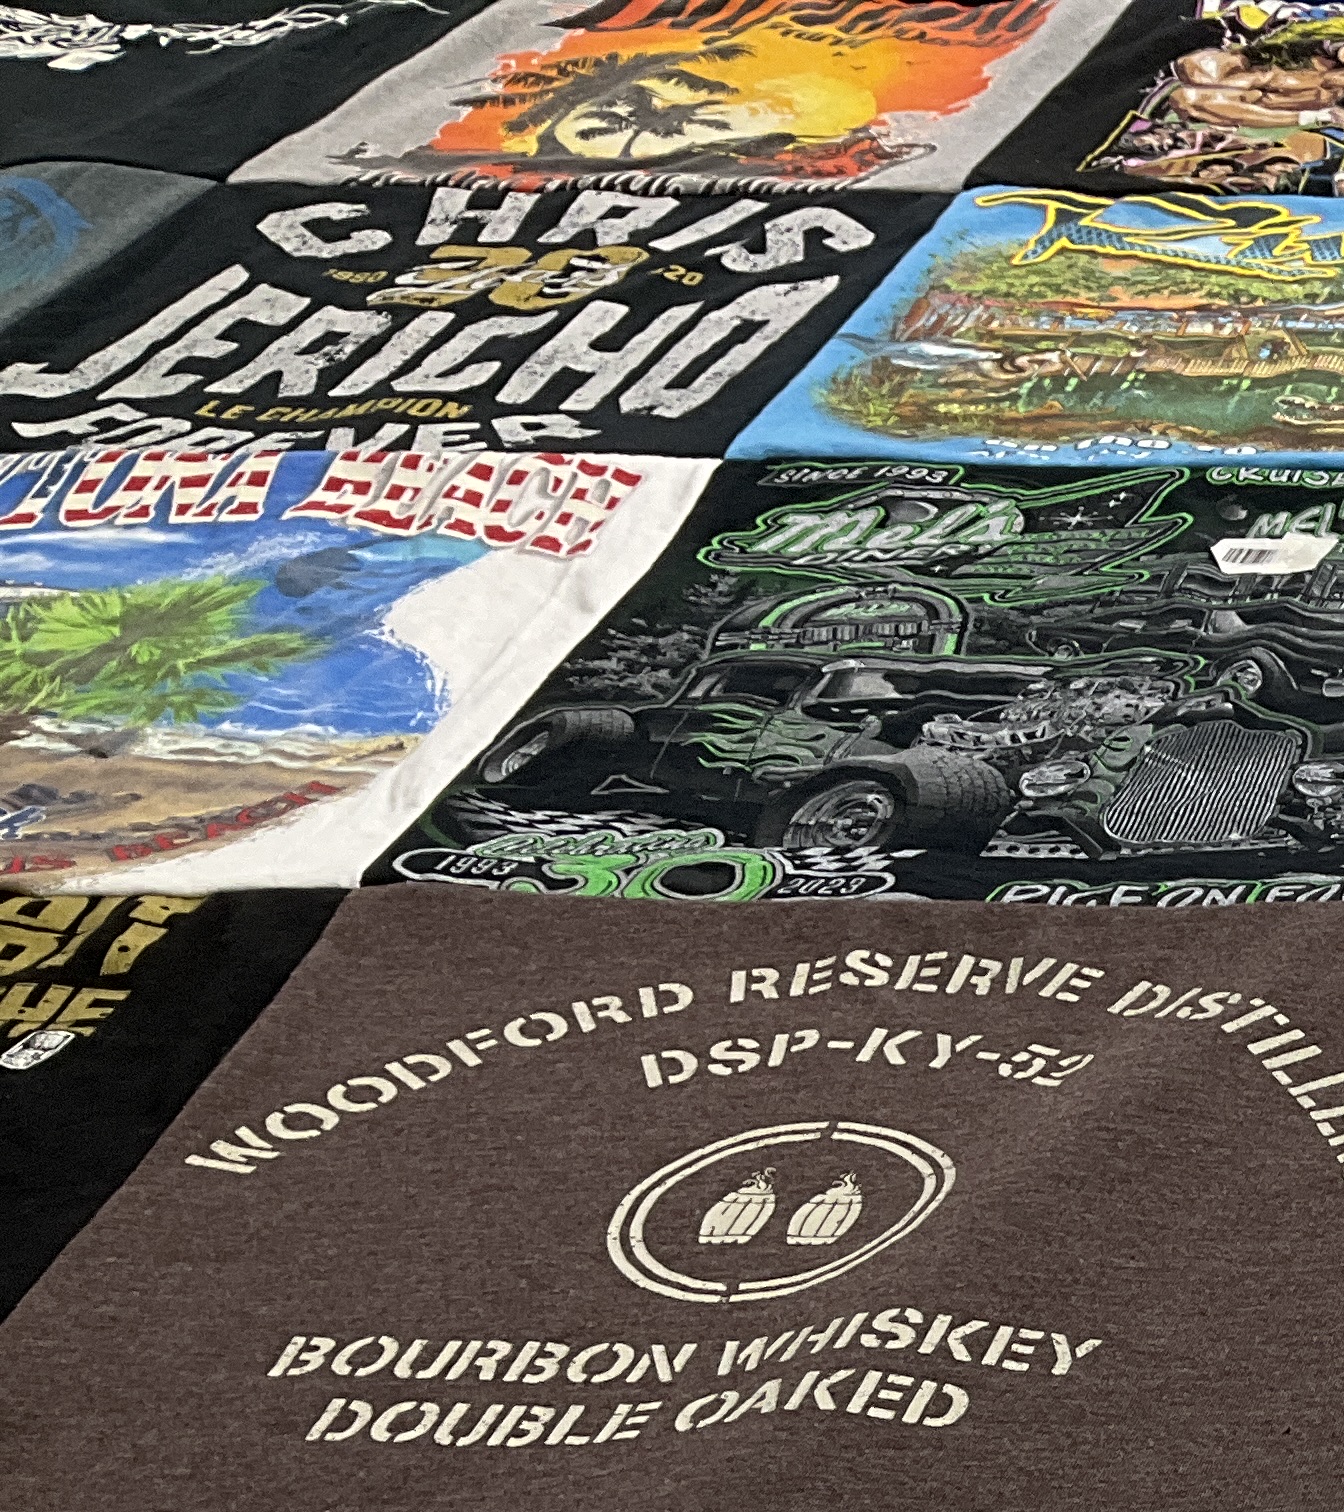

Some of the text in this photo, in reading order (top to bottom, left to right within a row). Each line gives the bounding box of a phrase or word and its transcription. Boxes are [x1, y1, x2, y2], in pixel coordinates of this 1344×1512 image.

[256, 187, 877, 274] CHRIS
[0, 264, 842, 420] JERICHO
[11, 403, 603, 455] FOREVER
[194, 397, 474, 425] LE CHAMPION
[774, 464, 950, 485] SINCE 1993
[433, 854, 518, 875] 1993
[775, 877, 867, 895] 2023
[186, 983, 696, 1175] WOODFORD
[727, 949, 1112, 1006] RESERVE
[640, 1028, 1095, 1090] DSP-KY-52
[267, 1308, 1103, 1386] BOURBON WHISKEY
[304, 1371, 972, 1449] DOUBLE OAKED
